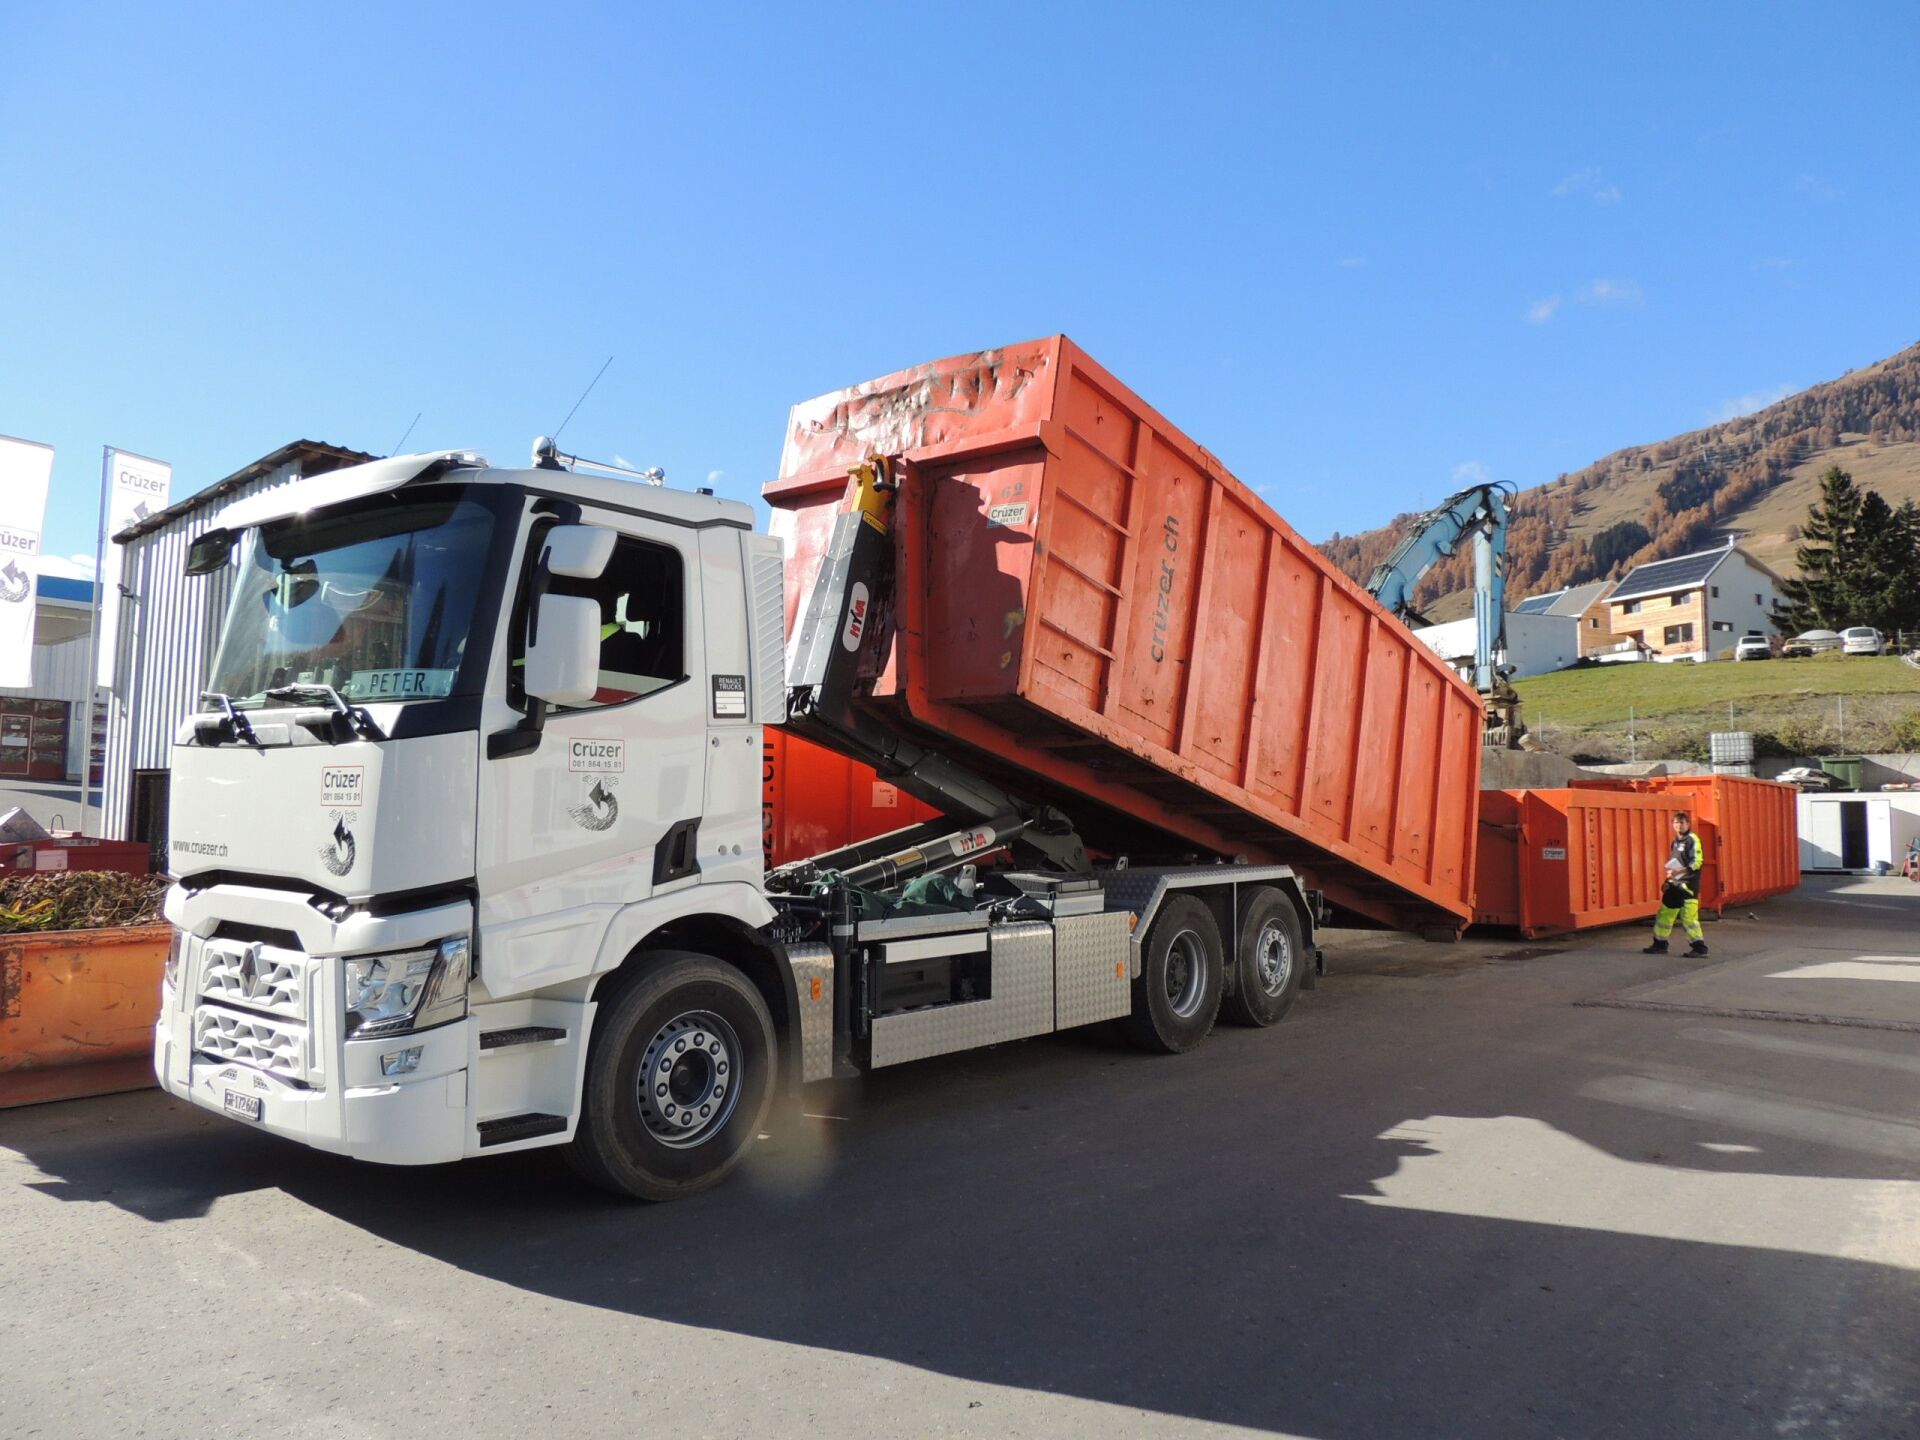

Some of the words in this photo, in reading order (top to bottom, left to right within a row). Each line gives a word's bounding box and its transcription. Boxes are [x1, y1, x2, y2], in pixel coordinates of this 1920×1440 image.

[0, 530, 36, 550] üzer
[368, 672, 426, 694] PETER
[572, 741, 622, 758] Crüzer
[324, 769, 361, 789] Crüzer
[172, 840, 228, 857] www.cruezer.ch
